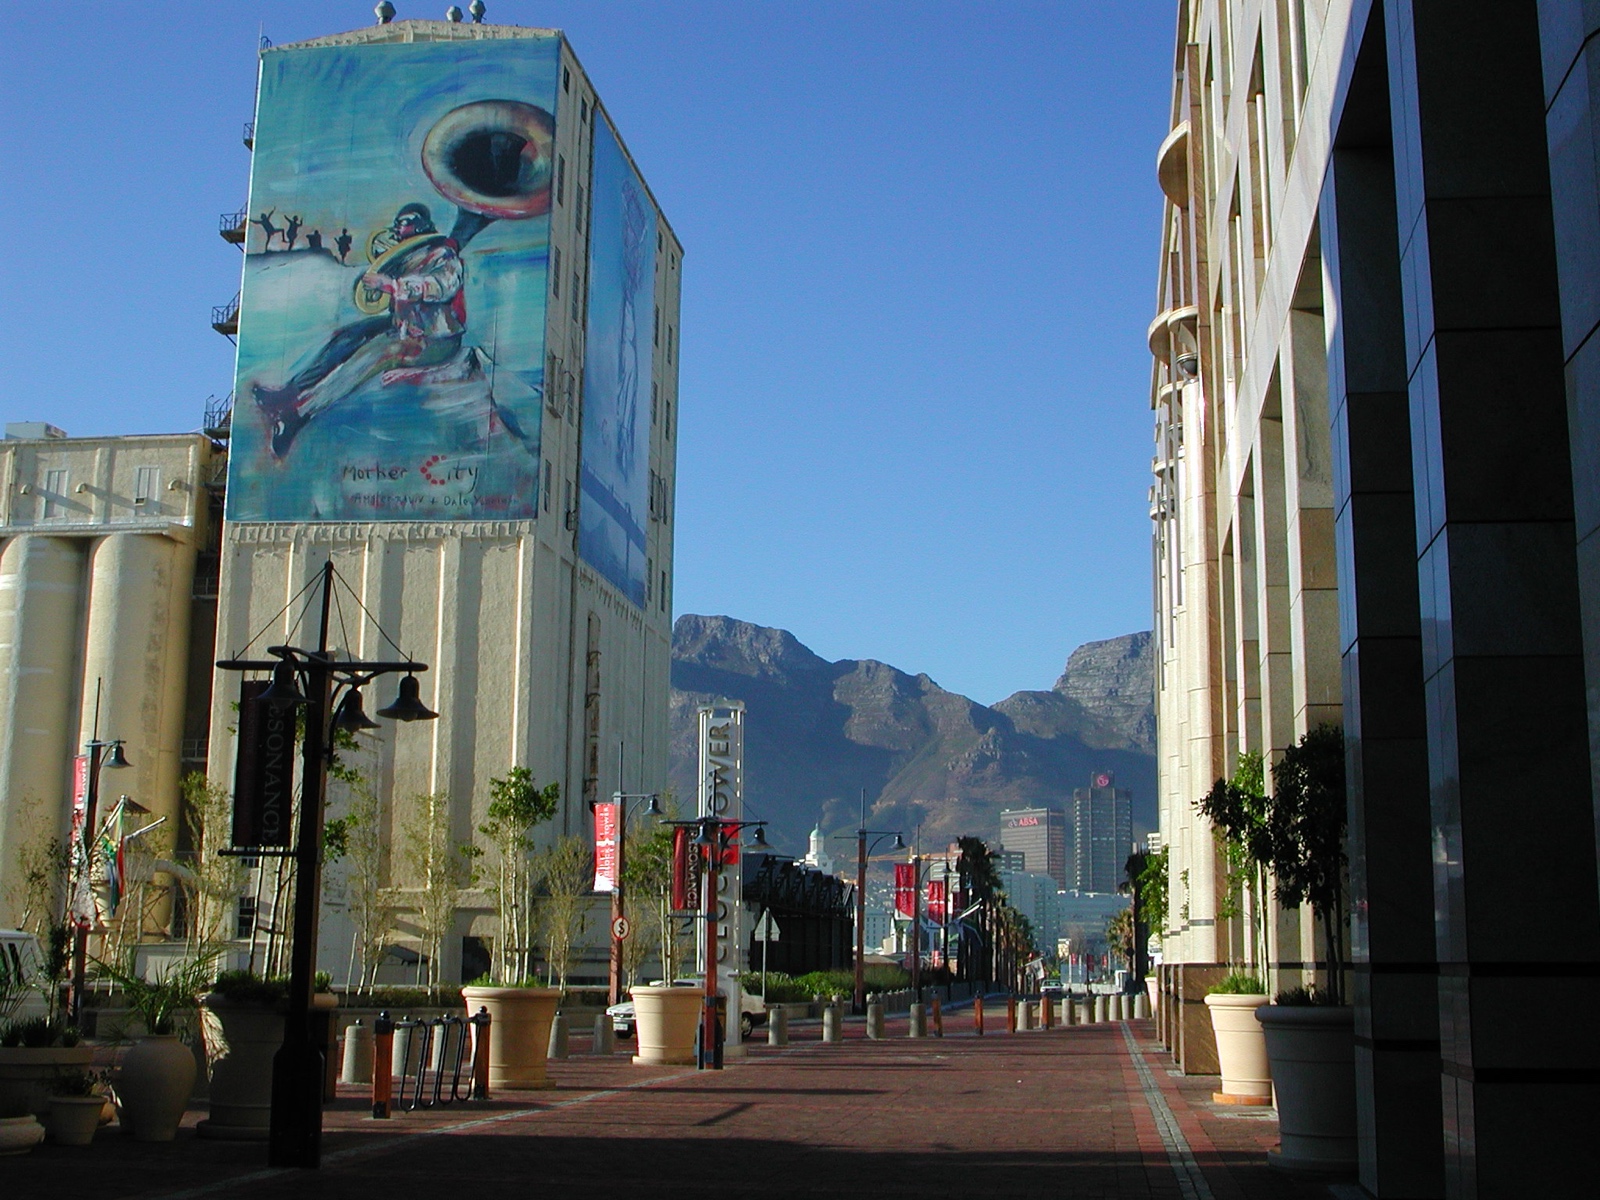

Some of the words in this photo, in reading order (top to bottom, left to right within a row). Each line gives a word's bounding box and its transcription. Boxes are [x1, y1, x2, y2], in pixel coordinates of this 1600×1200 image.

[343, 462, 408, 482] Mother
[420, 455, 479, 494] City
[262, 702, 286, 842] ESONANCE
[708, 722, 731, 817] OWER
[1018, 817, 1038, 827] ABSA
